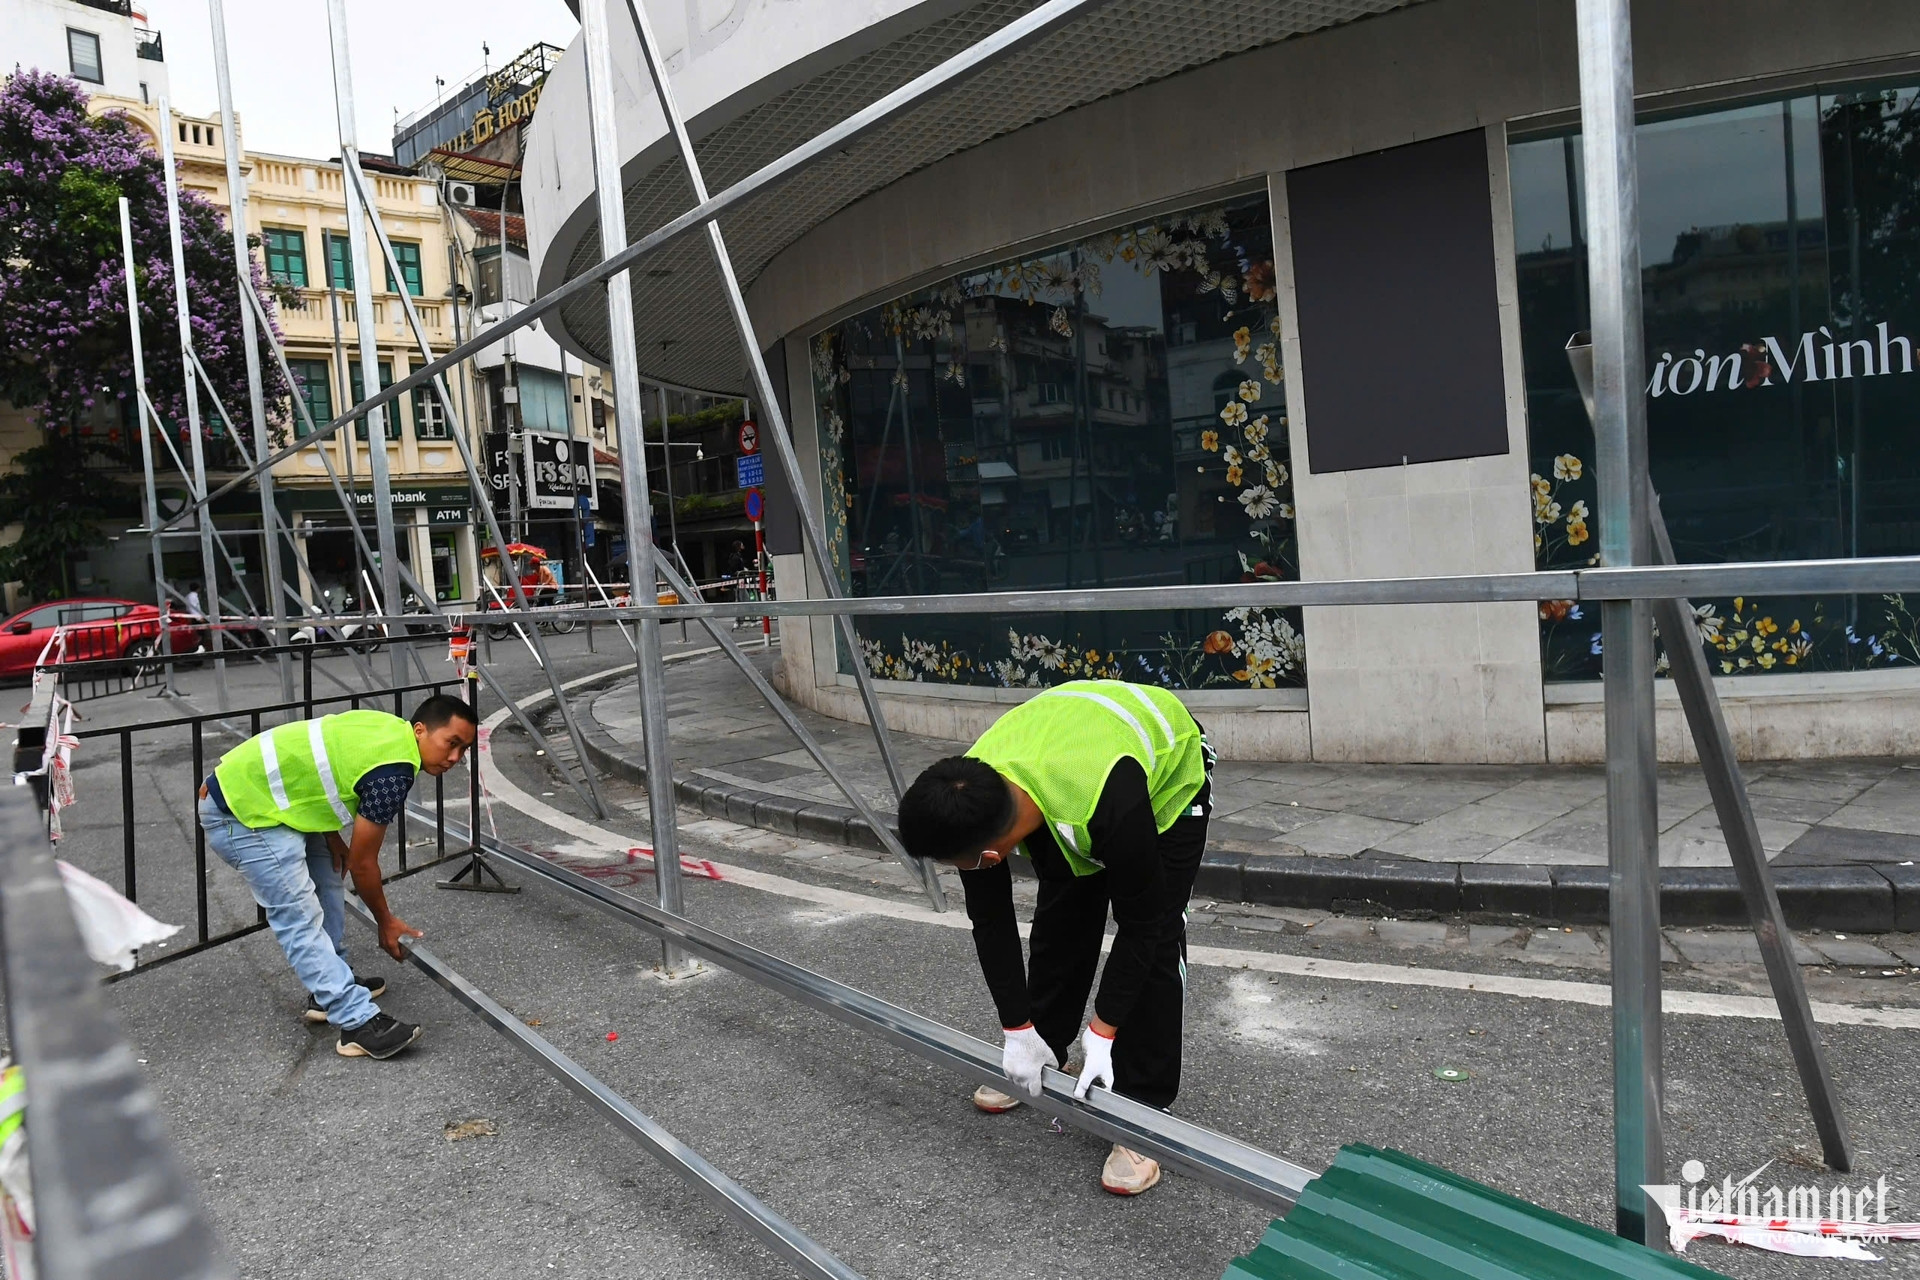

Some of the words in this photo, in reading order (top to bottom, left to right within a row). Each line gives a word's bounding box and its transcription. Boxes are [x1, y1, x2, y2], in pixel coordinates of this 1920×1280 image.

[1645, 348, 1745, 398] ươn
[1760, 321, 1913, 387] Mình
[535, 461, 557, 482] FS
[436, 510, 461, 520] ATM
